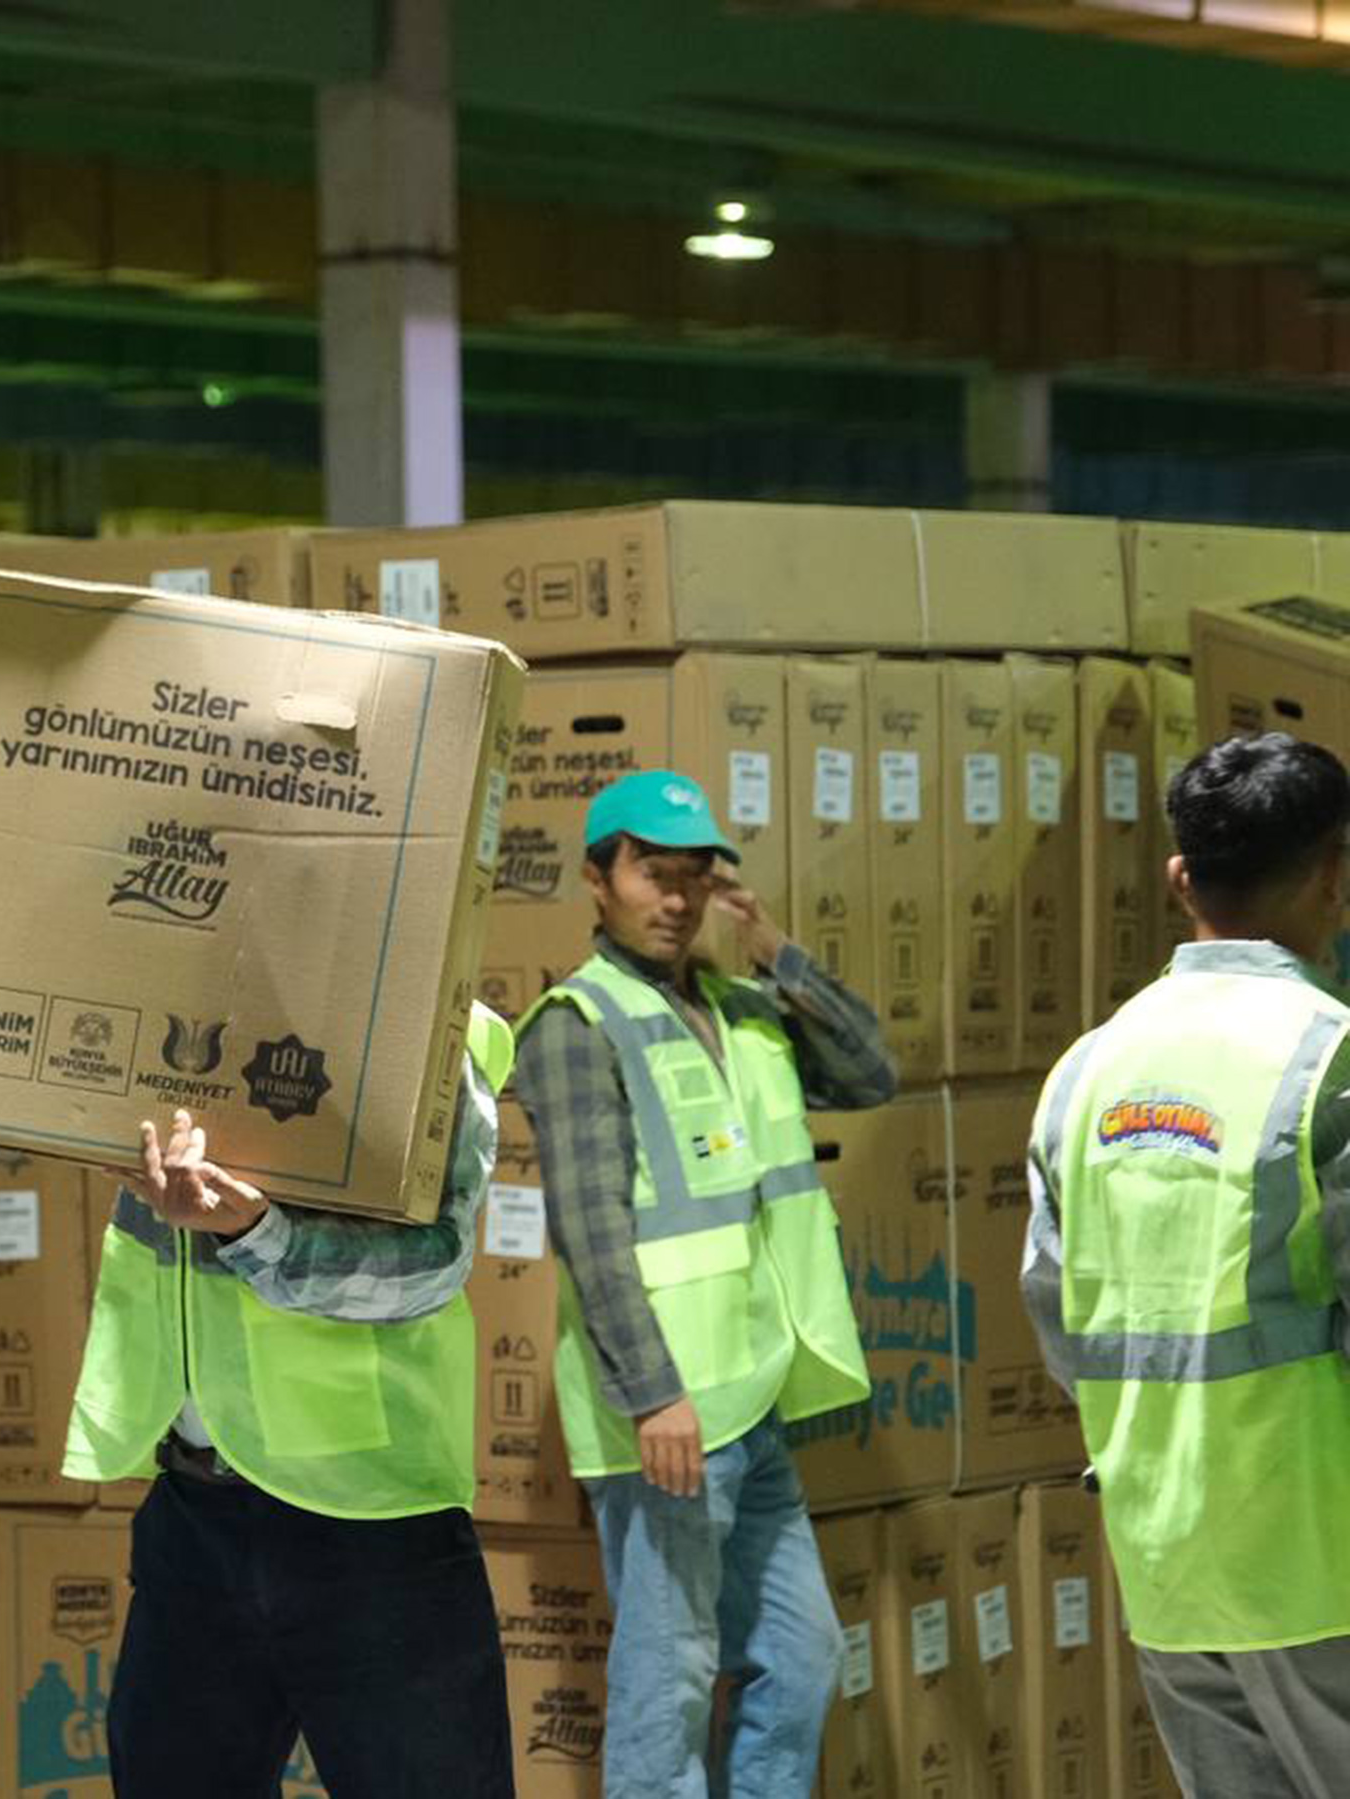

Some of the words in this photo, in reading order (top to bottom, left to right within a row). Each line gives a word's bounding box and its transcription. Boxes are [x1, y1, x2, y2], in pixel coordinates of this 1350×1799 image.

[152, 680, 249, 723] Sizler
[24, 703, 232, 759] gönlümüzün
[0, 737, 189, 788] yarınımızın
[201, 765, 383, 818] ümidisiniz.
[146, 819, 213, 846] UĞUR
[107, 859, 230, 921] Altay
